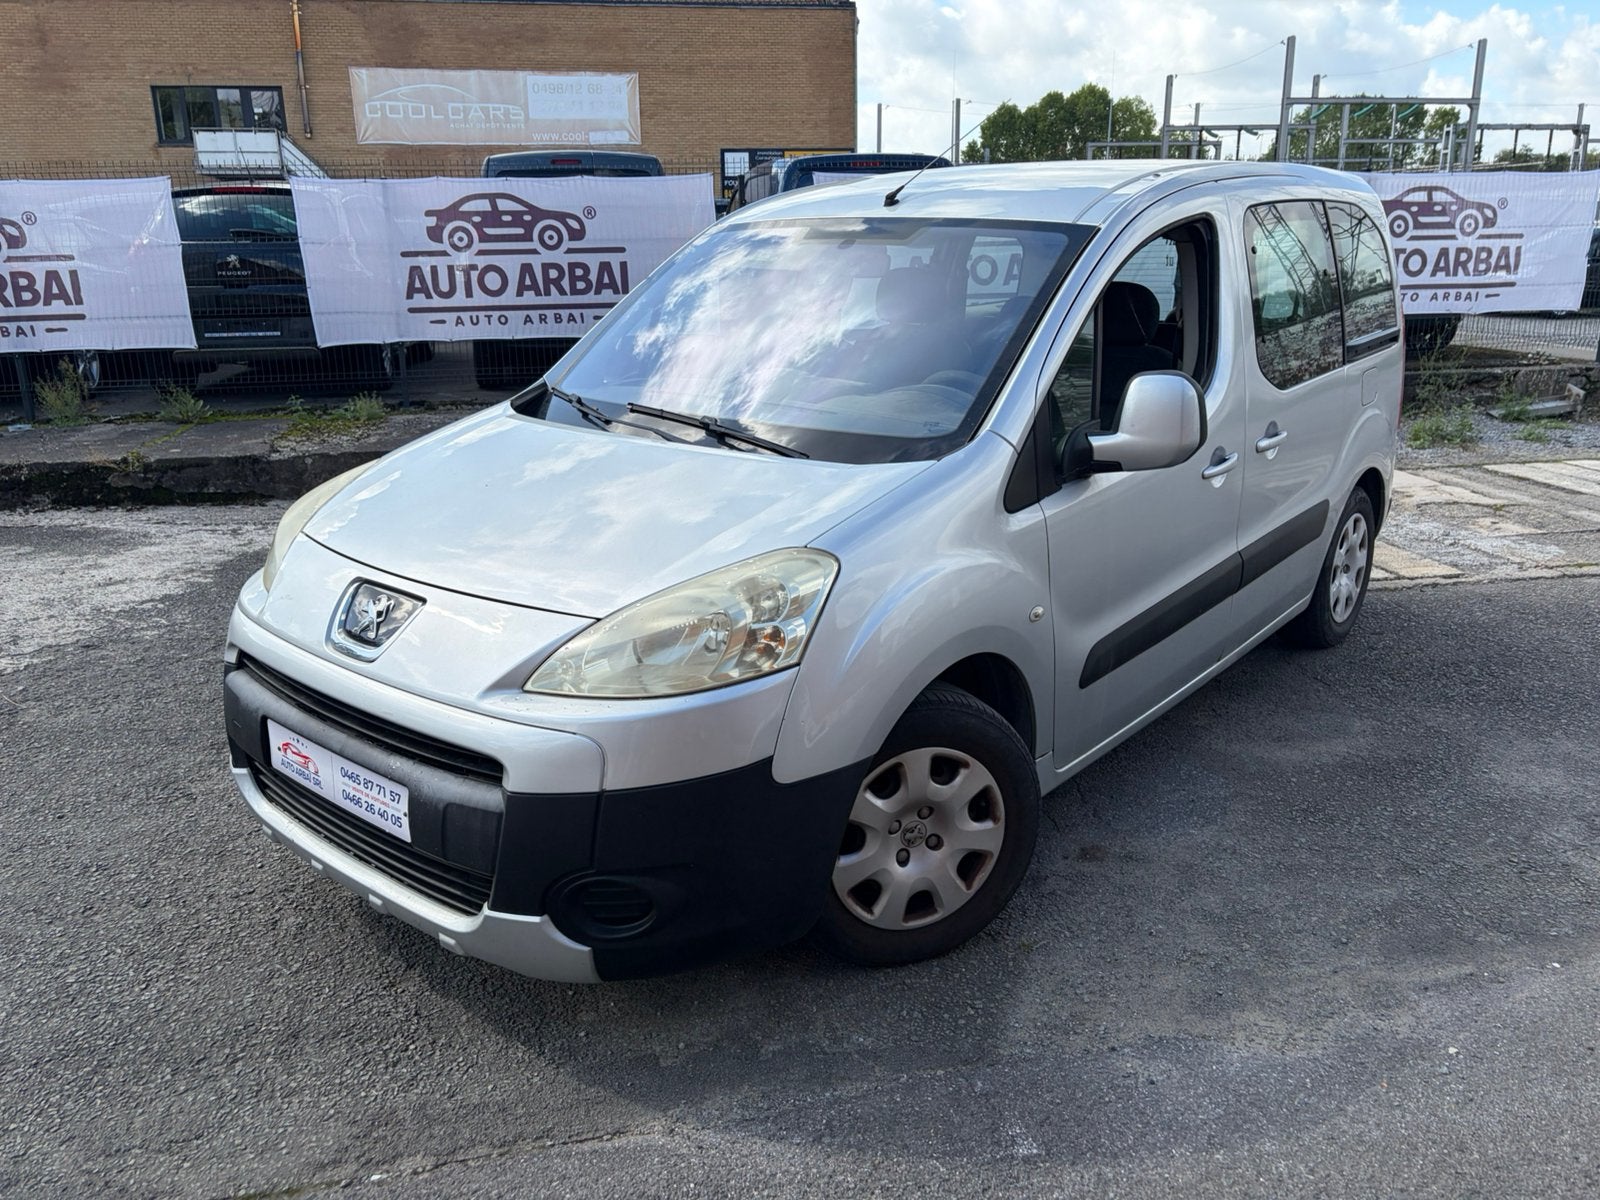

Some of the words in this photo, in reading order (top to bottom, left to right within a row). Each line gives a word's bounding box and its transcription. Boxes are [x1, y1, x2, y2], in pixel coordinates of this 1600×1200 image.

[1430, 245, 1522, 277] ARBAI
[406, 264, 509, 300] AUTO
[516, 261, 630, 298] ARBAI
[1429, 291, 1480, 303] ARBAI
[454, 314, 509, 328] AUTO
[523, 312, 585, 326] ARBAI
[281, 758, 295, 773] AUTO
[340, 766, 361, 786] 0465
[363, 777, 374, 791] 87
[376, 783, 386, 799] 71
[389, 790, 401, 804] 57
[342, 789, 363, 808] 0466
[364, 800, 376, 815] 26
[377, 808, 389, 821] 40
[390, 813, 402, 828] 05
